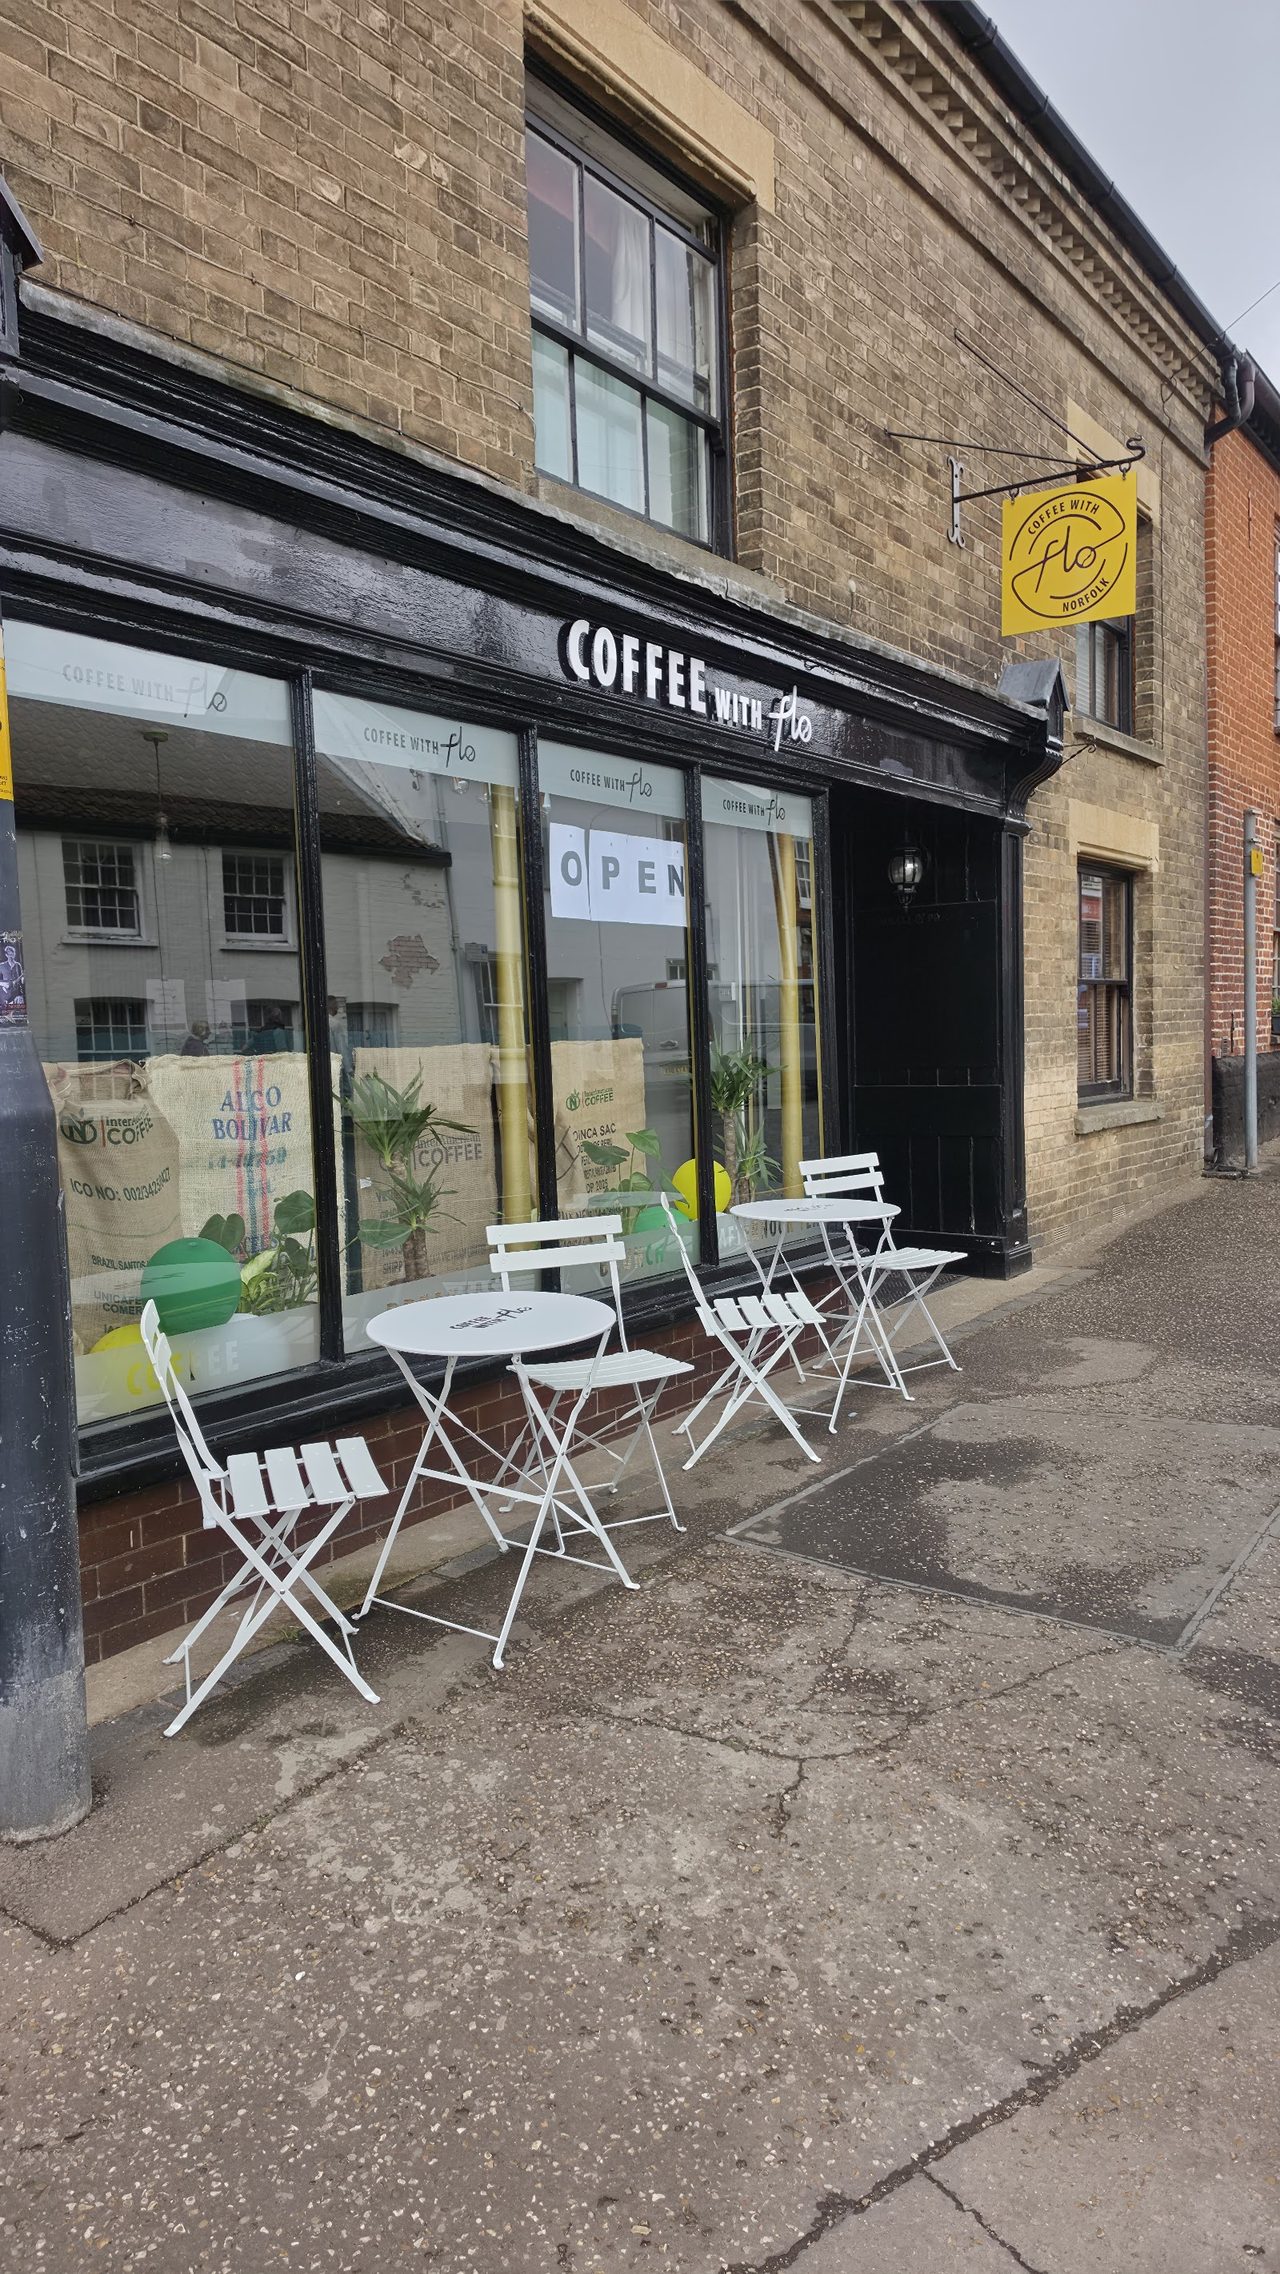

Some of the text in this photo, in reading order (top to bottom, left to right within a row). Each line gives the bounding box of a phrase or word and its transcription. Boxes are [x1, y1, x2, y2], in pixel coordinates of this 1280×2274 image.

[1027, 499, 1100, 535] COFFEE WITH
[1062, 578, 1110, 613] NORFOLK
[63, 664, 125, 692] COFFEE
[131, 677, 174, 702] WITH
[568, 619, 813, 751] COFFEE WITH flo
[363, 727, 406, 749] COFFEE
[410, 736, 439, 755] WITH
[569, 768, 601, 787] COFFEE
[603, 775, 625, 791] WITH
[722, 799, 747, 814] COFFEE
[748, 803, 765, 816] WITH
[560, 850, 685, 898] OPEN
[220, 1085, 282, 1112] ALCO
[584, 1092, 614, 1107] COFFEE
[212, 1111, 292, 1141] BOLIVAR
[418, 1143, 482, 1168] COFFEE
[70, 1178, 94, 1198] ICO
[91, 1254, 118, 1270] BRAZIL
